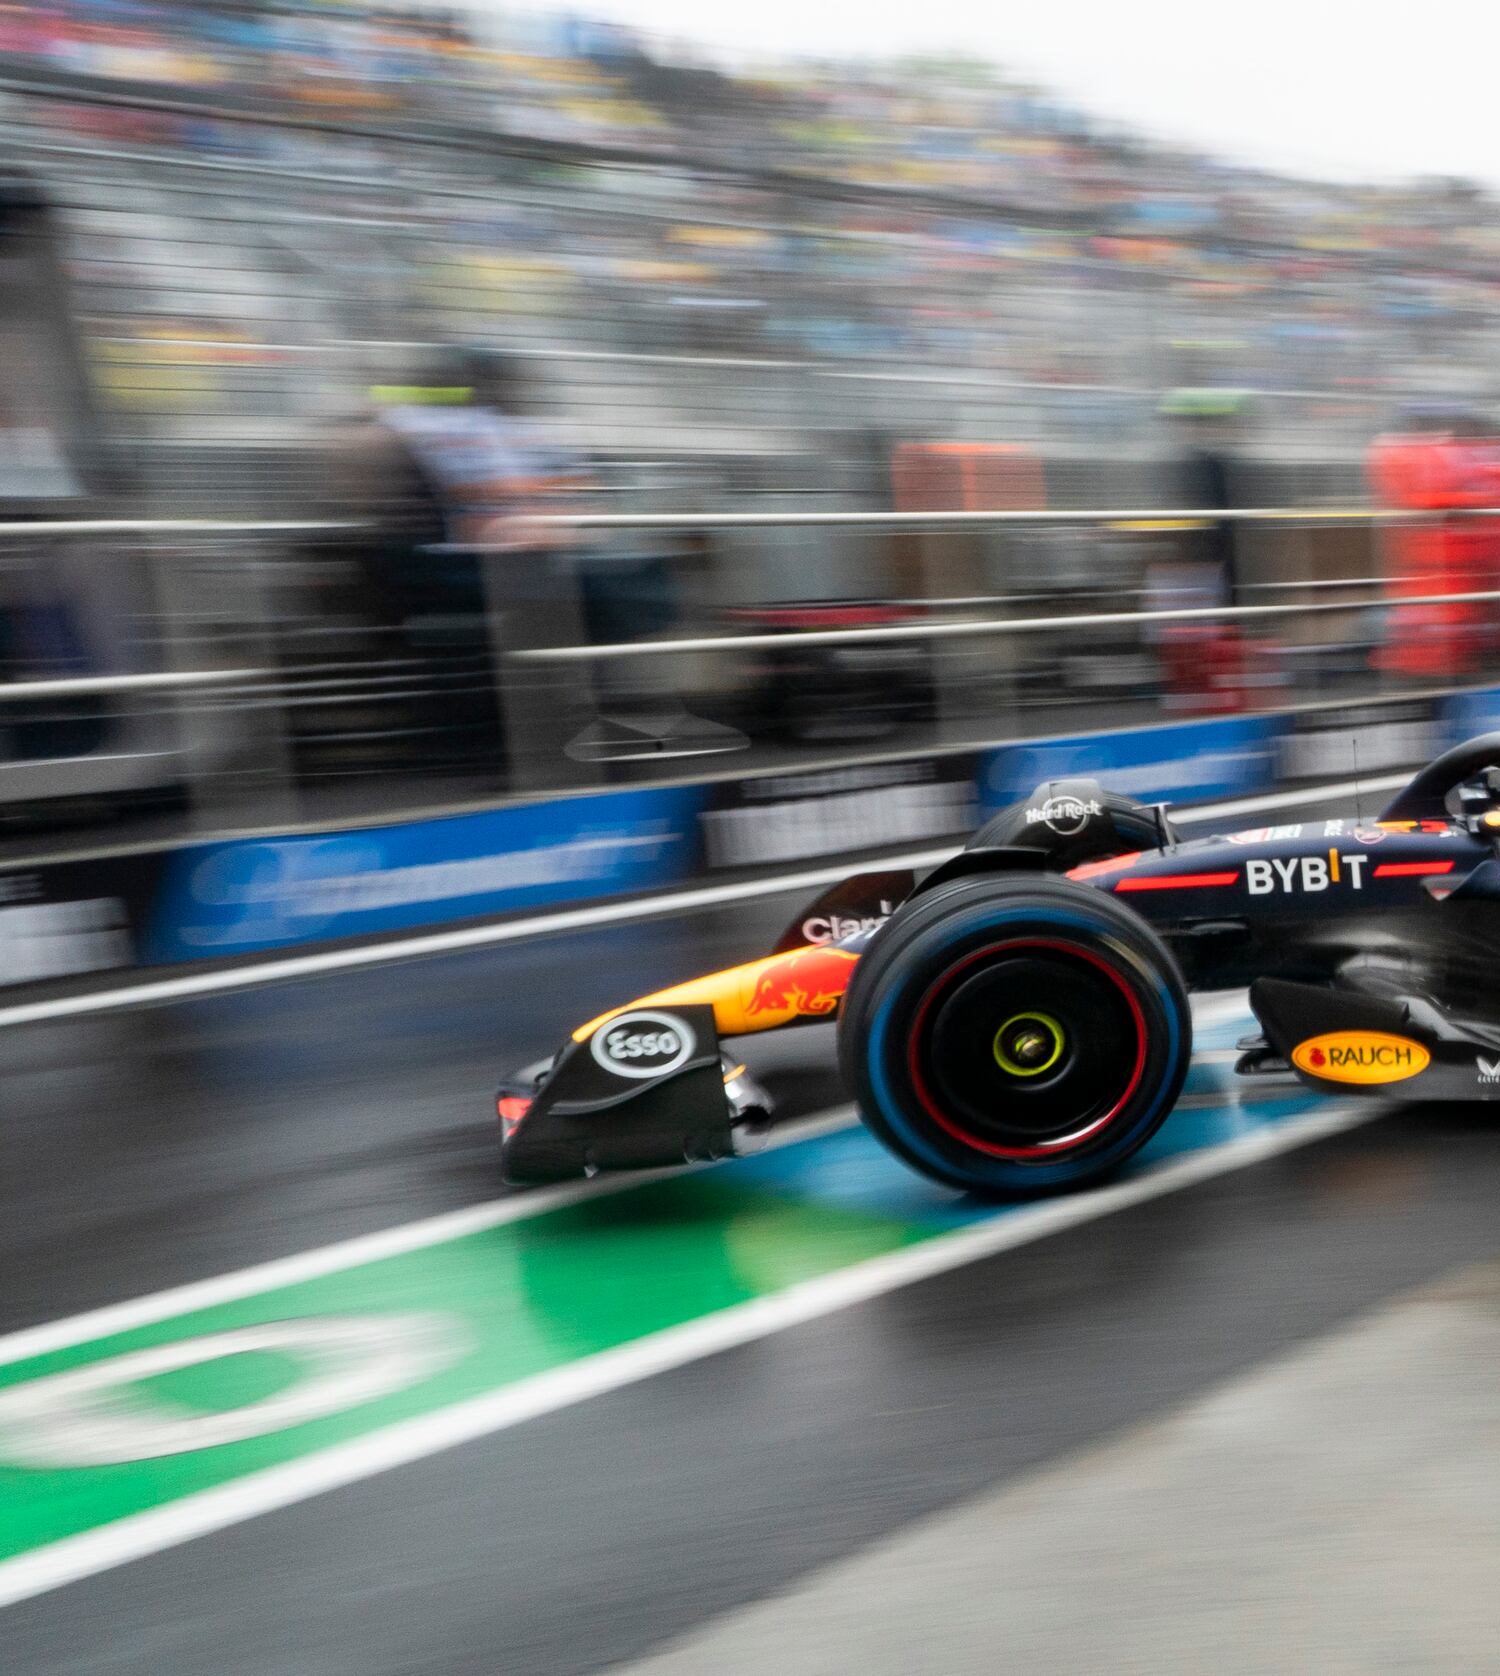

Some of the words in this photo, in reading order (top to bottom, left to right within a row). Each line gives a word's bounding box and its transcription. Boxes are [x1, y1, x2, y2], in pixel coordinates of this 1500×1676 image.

[1025, 804, 1063, 824] Hard
[1064, 800, 1103, 819] Rock
[1246, 848, 1368, 895] BYBIT
[607, 1030, 681, 1059] Esso
[1329, 1046, 1412, 1067] RAUCH
